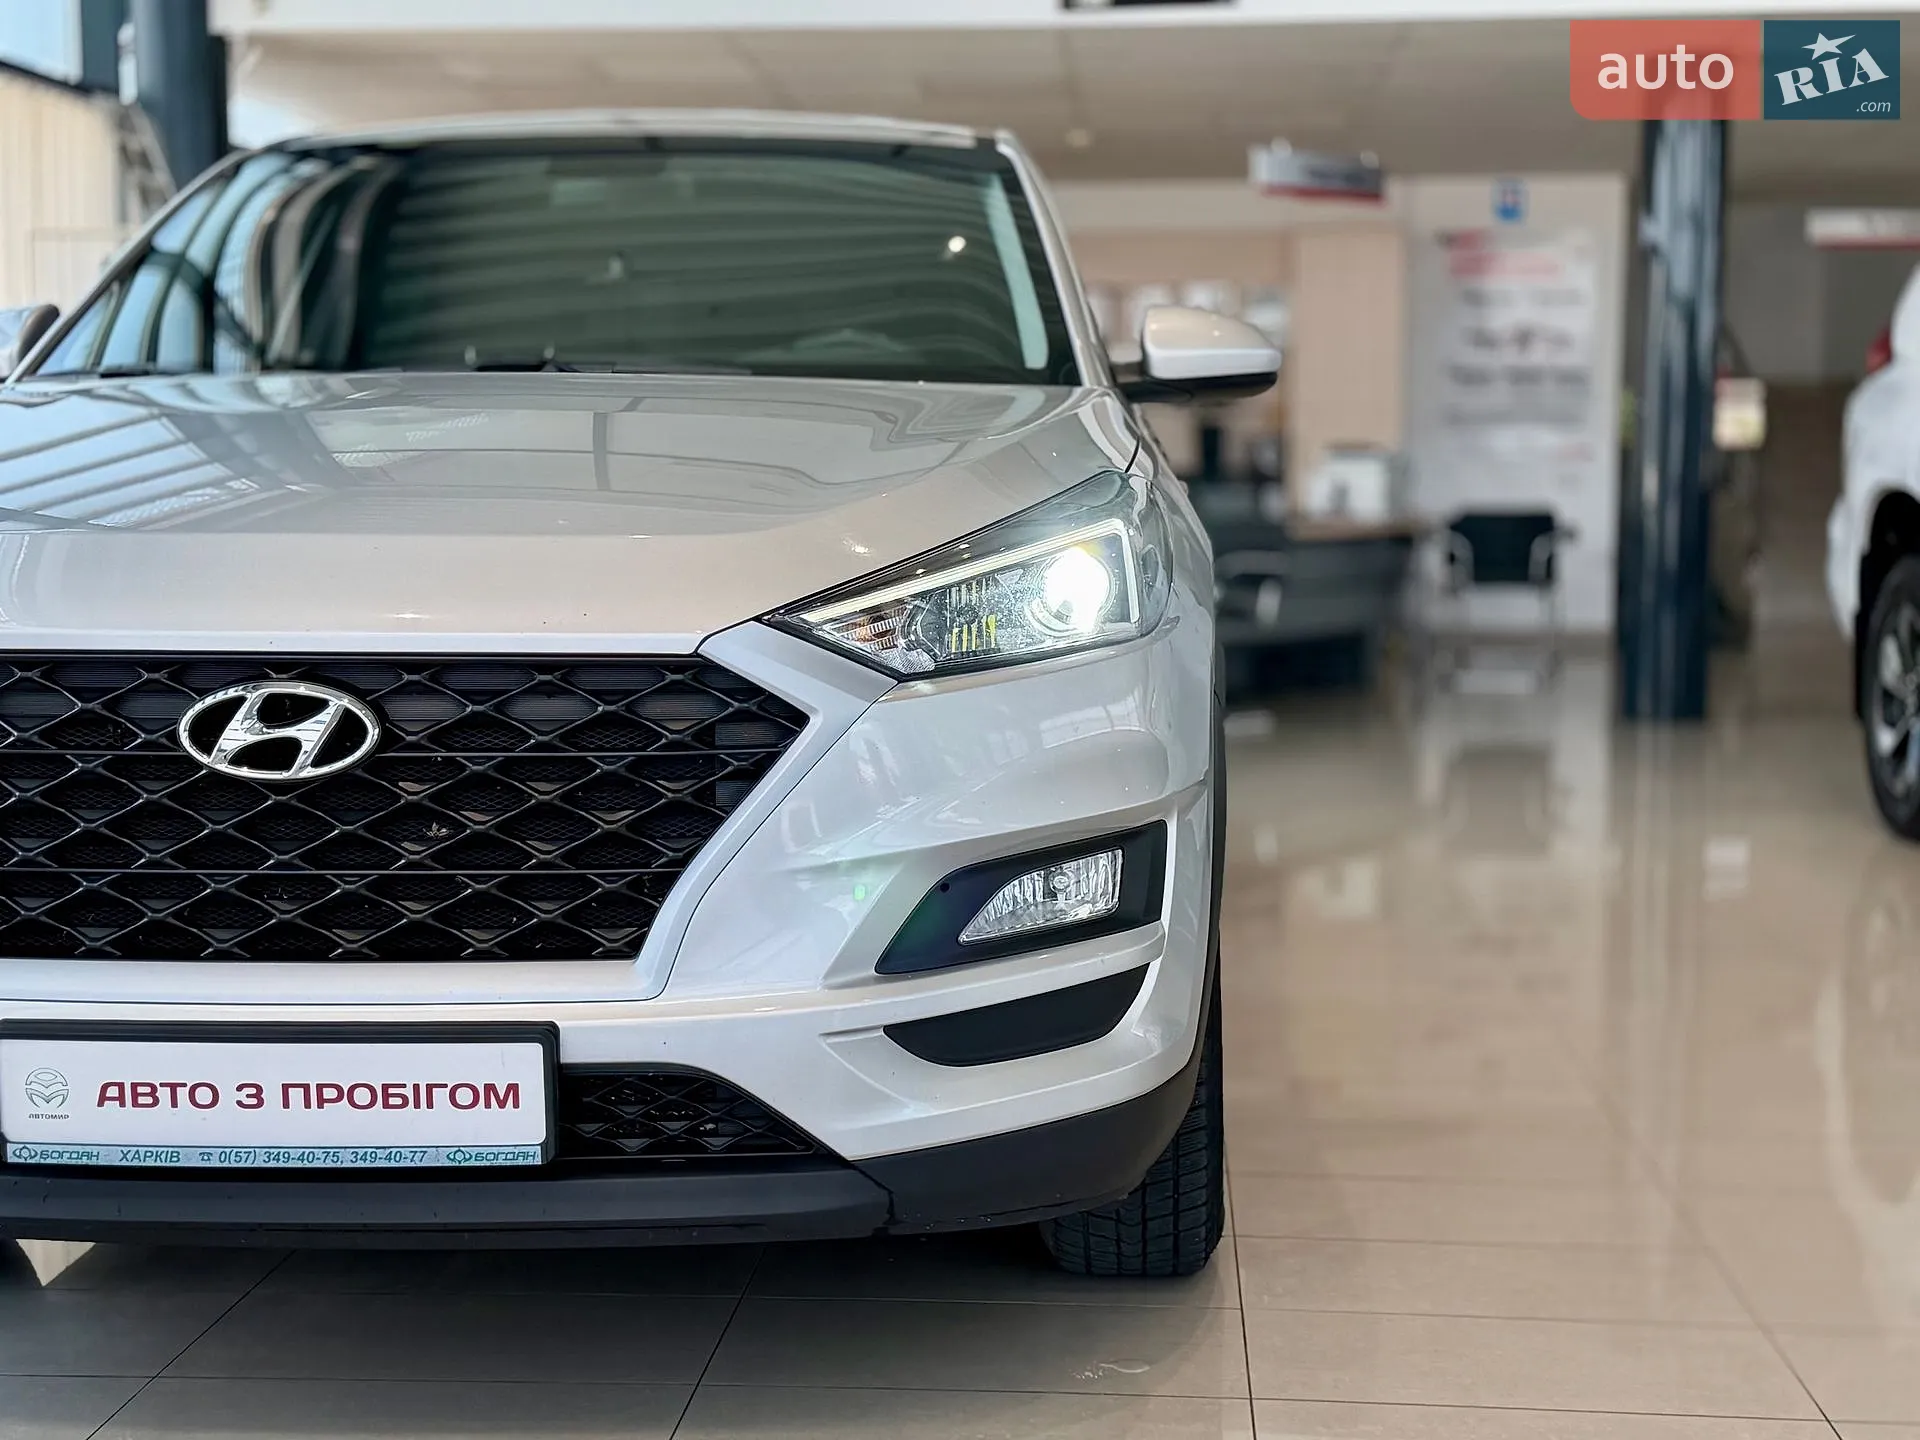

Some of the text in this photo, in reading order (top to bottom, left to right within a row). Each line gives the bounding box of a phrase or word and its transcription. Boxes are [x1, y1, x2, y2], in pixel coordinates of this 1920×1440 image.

[96, 1081, 521, 1111] АВТО З ПРОБІГОМ
[39, 1149, 537, 1165] БОГДАН ХАРКІВ 0(57) 349-40-75, 349-40-77 БОГДАН
